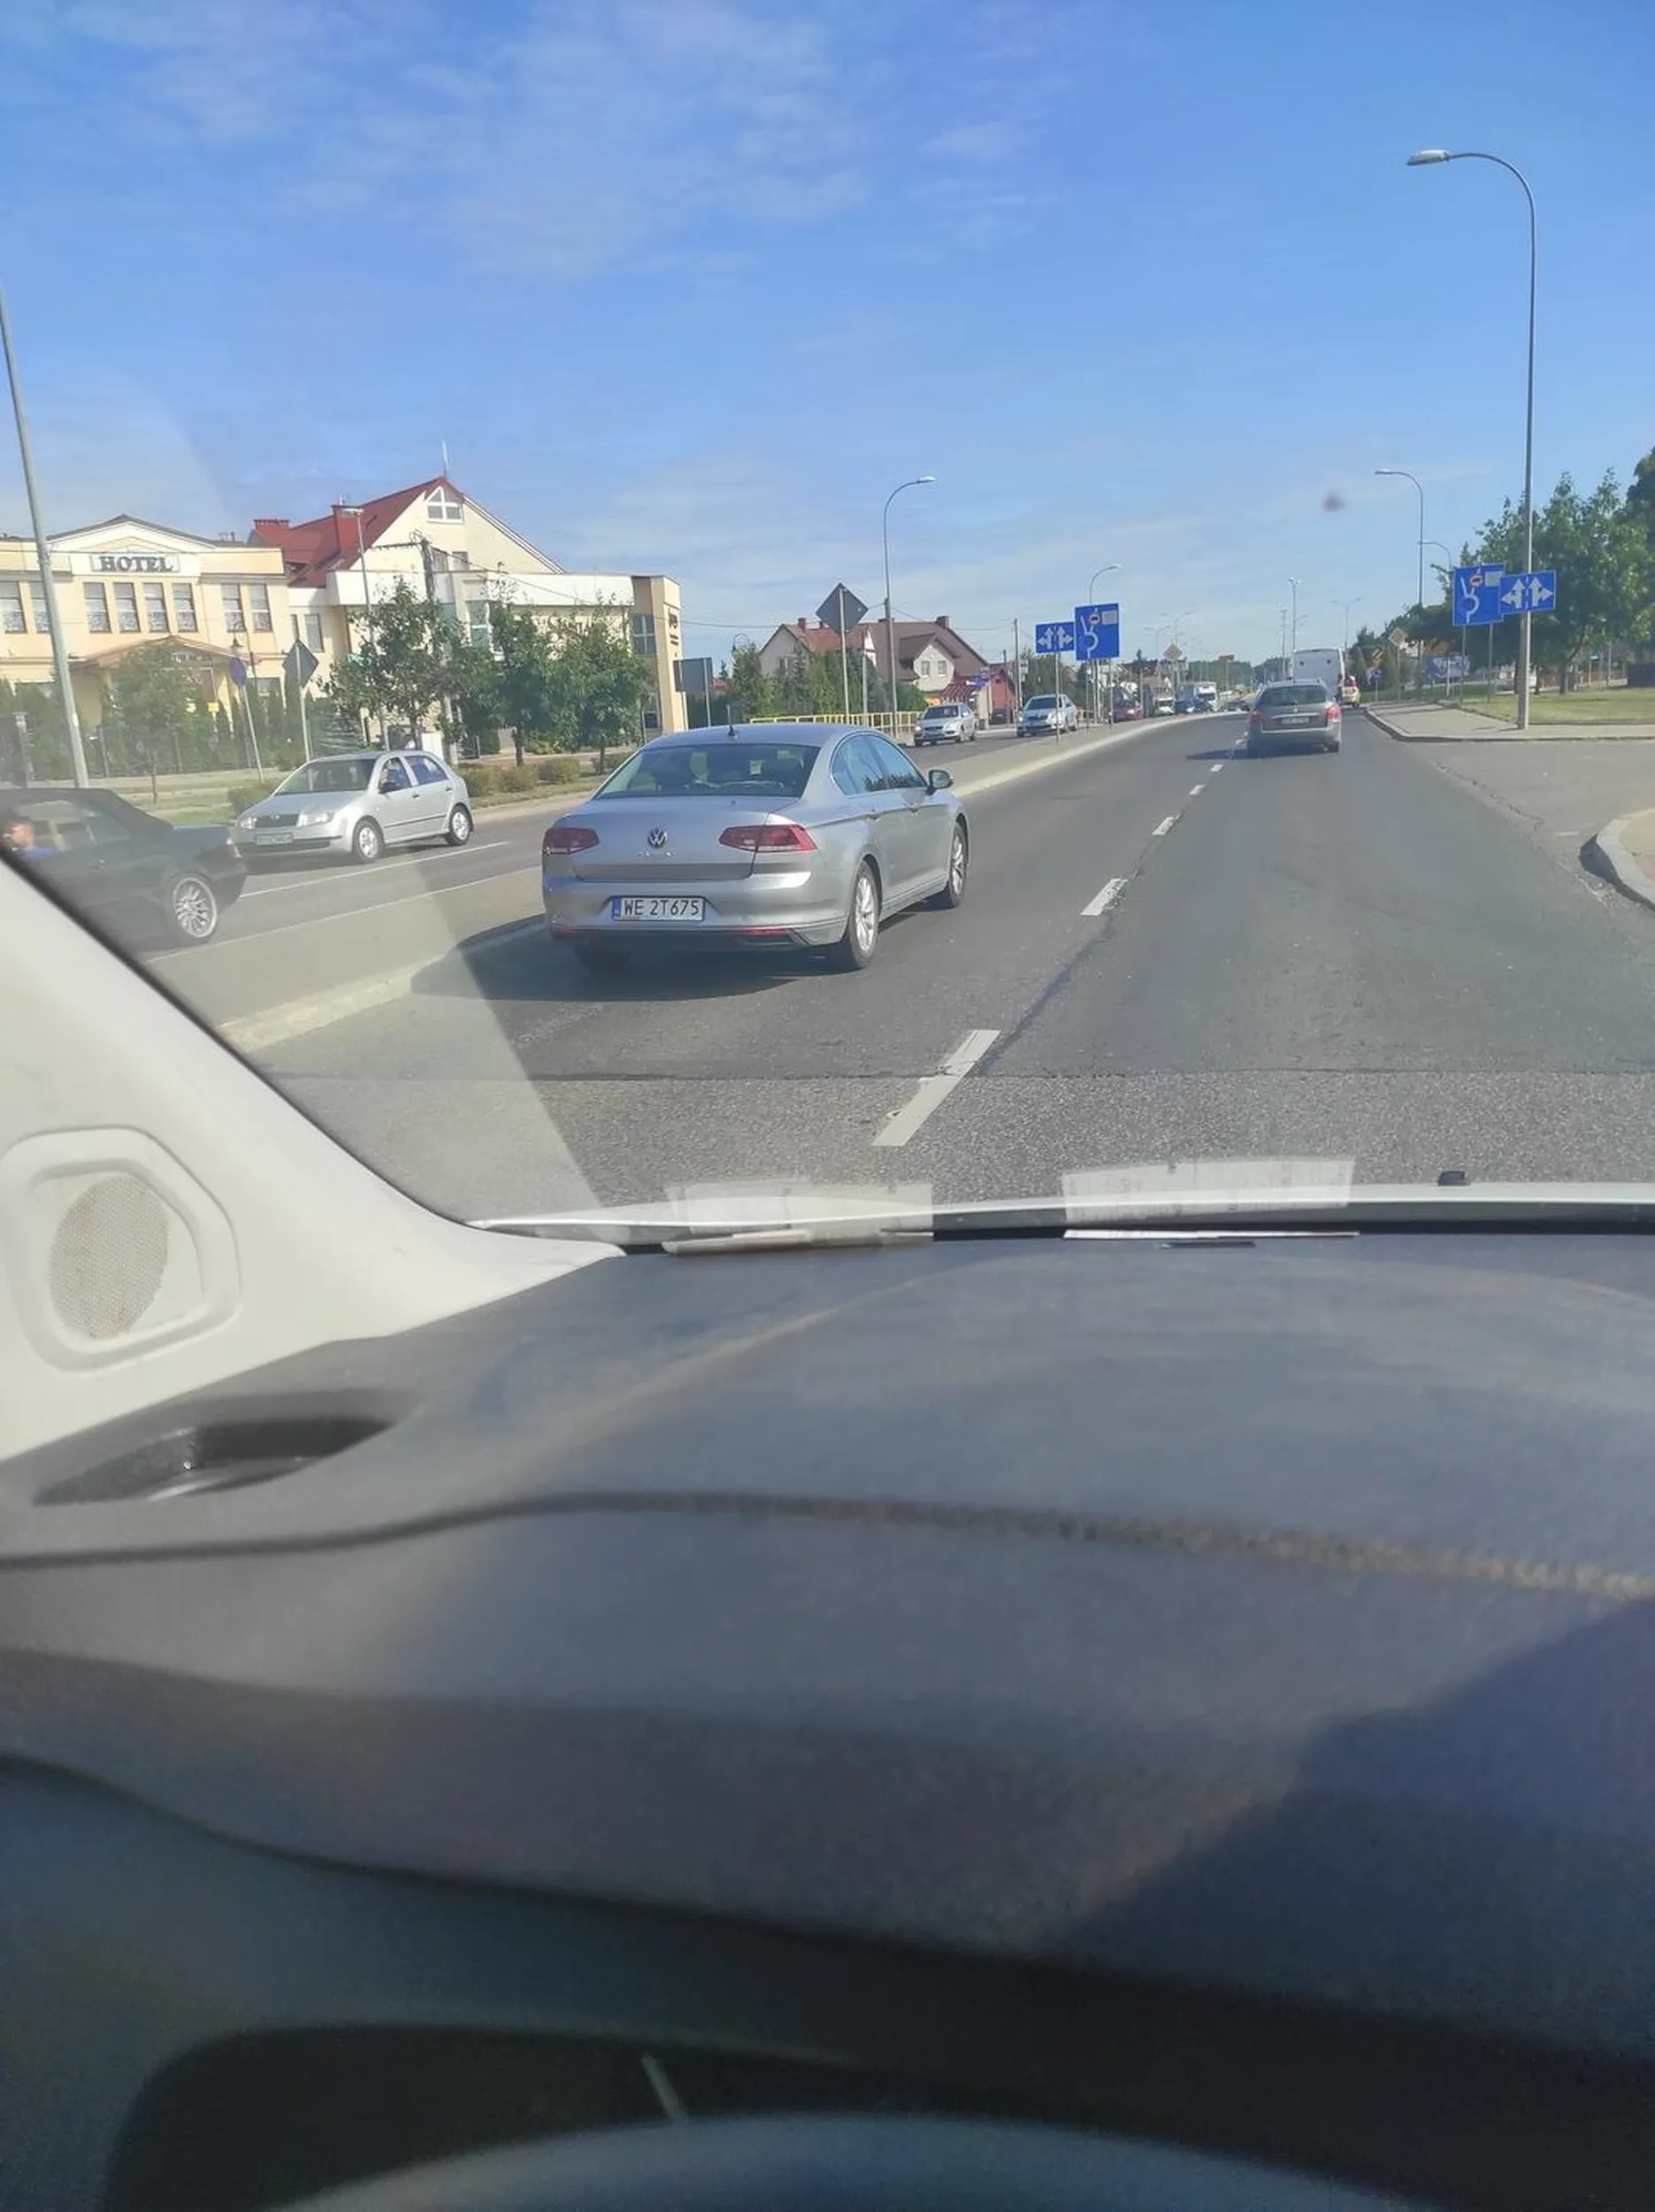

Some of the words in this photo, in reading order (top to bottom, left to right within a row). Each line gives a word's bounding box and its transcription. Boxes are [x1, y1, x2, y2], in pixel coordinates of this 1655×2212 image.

[99, 556, 173, 572] HOTEL
[624, 900, 644, 916] WE
[650, 900, 699, 916] 2T675
